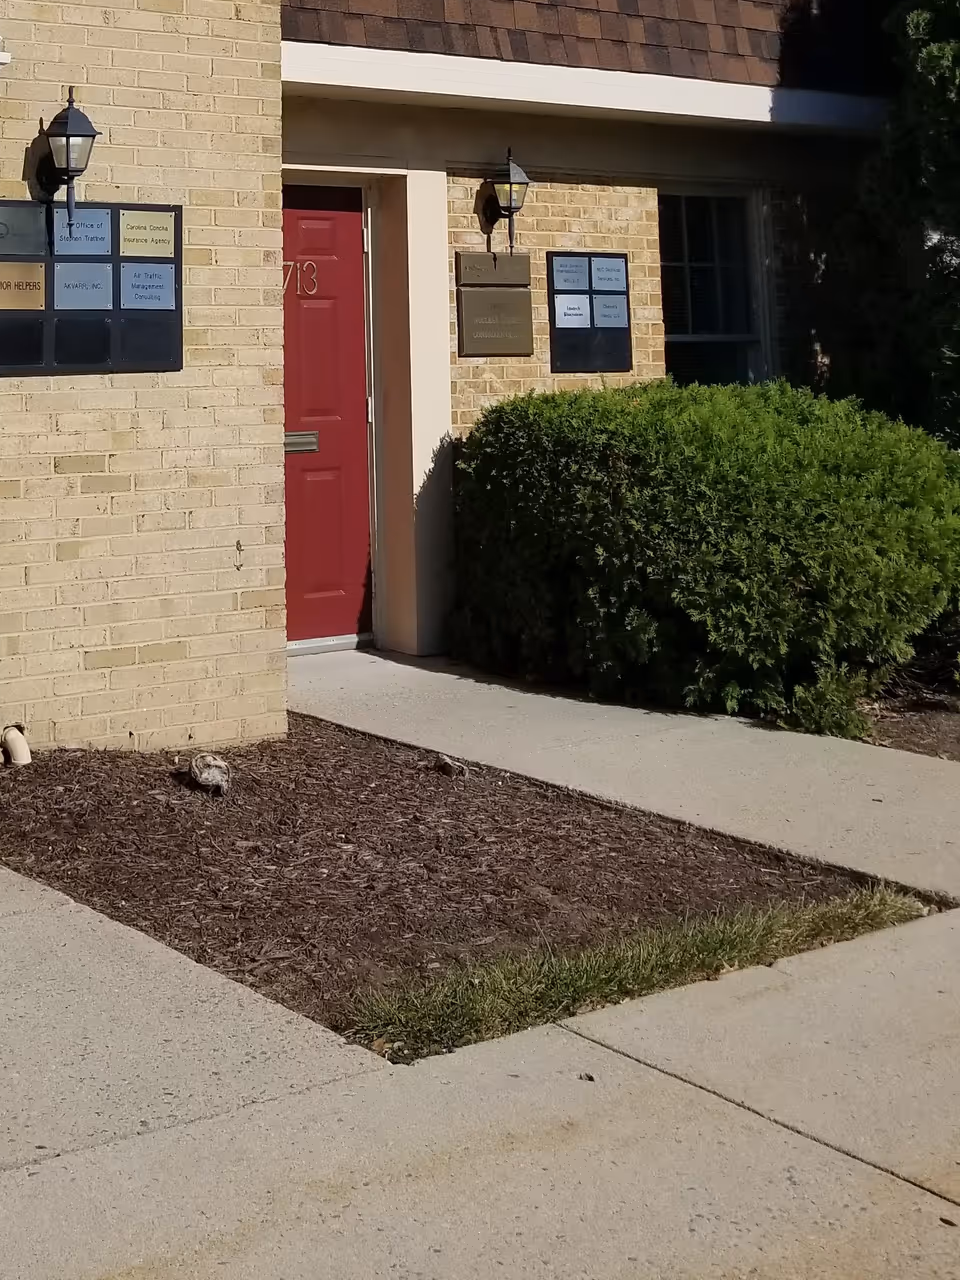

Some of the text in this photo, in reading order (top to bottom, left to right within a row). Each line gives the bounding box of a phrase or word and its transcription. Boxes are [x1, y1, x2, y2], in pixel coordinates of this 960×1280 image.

[126, 223, 147, 231] Carolina
[150, 237, 171, 245] Agency
[14, 281, 41, 291] HELPERS
